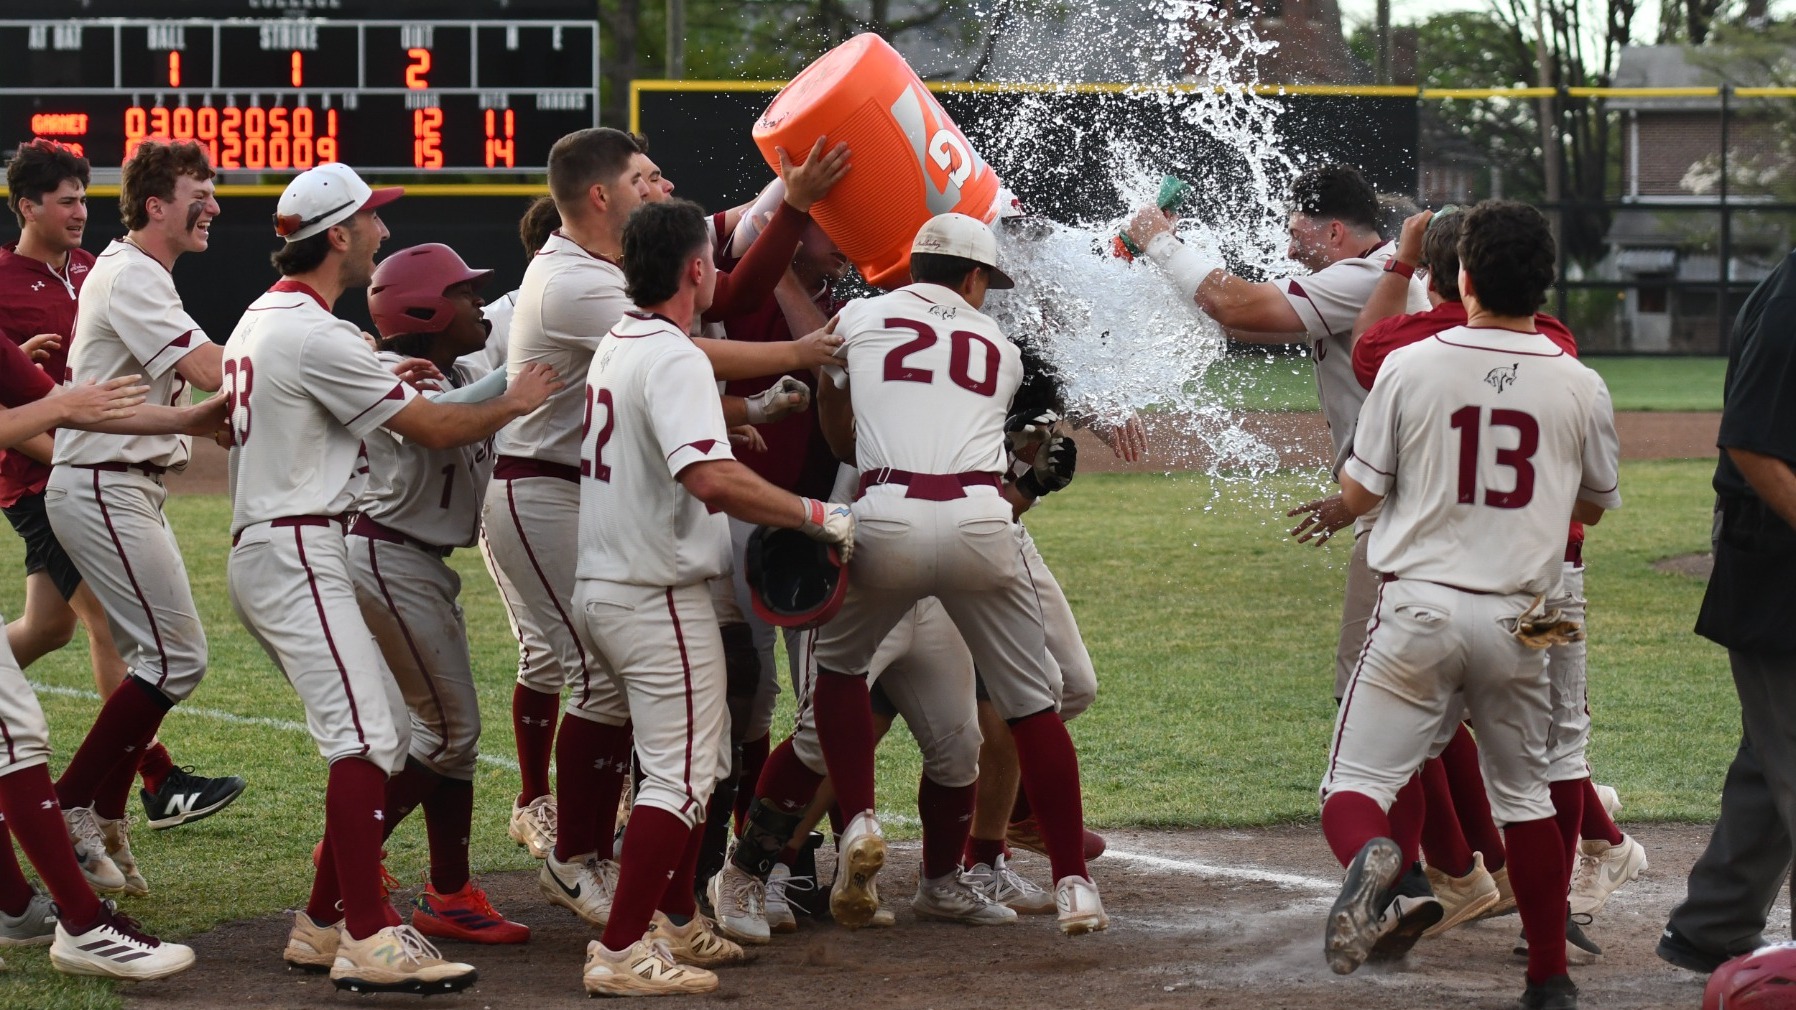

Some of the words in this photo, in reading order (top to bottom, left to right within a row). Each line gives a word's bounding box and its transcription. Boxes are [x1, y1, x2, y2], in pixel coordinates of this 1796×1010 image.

[147, 25, 186, 50] BALL
[259, 25, 318, 50] STRIKE
[169, 50, 180, 87] 1
[291, 50, 302, 87] 1
[405, 47, 431, 90] 2
[414, 107, 443, 138] 12
[485, 109, 514, 138] 11
[414, 138, 443, 170] 15
[485, 138, 514, 169] 14
[884, 317, 1001, 397] 20
[1450, 404, 1540, 509] 13
[440, 463, 456, 509] 1
